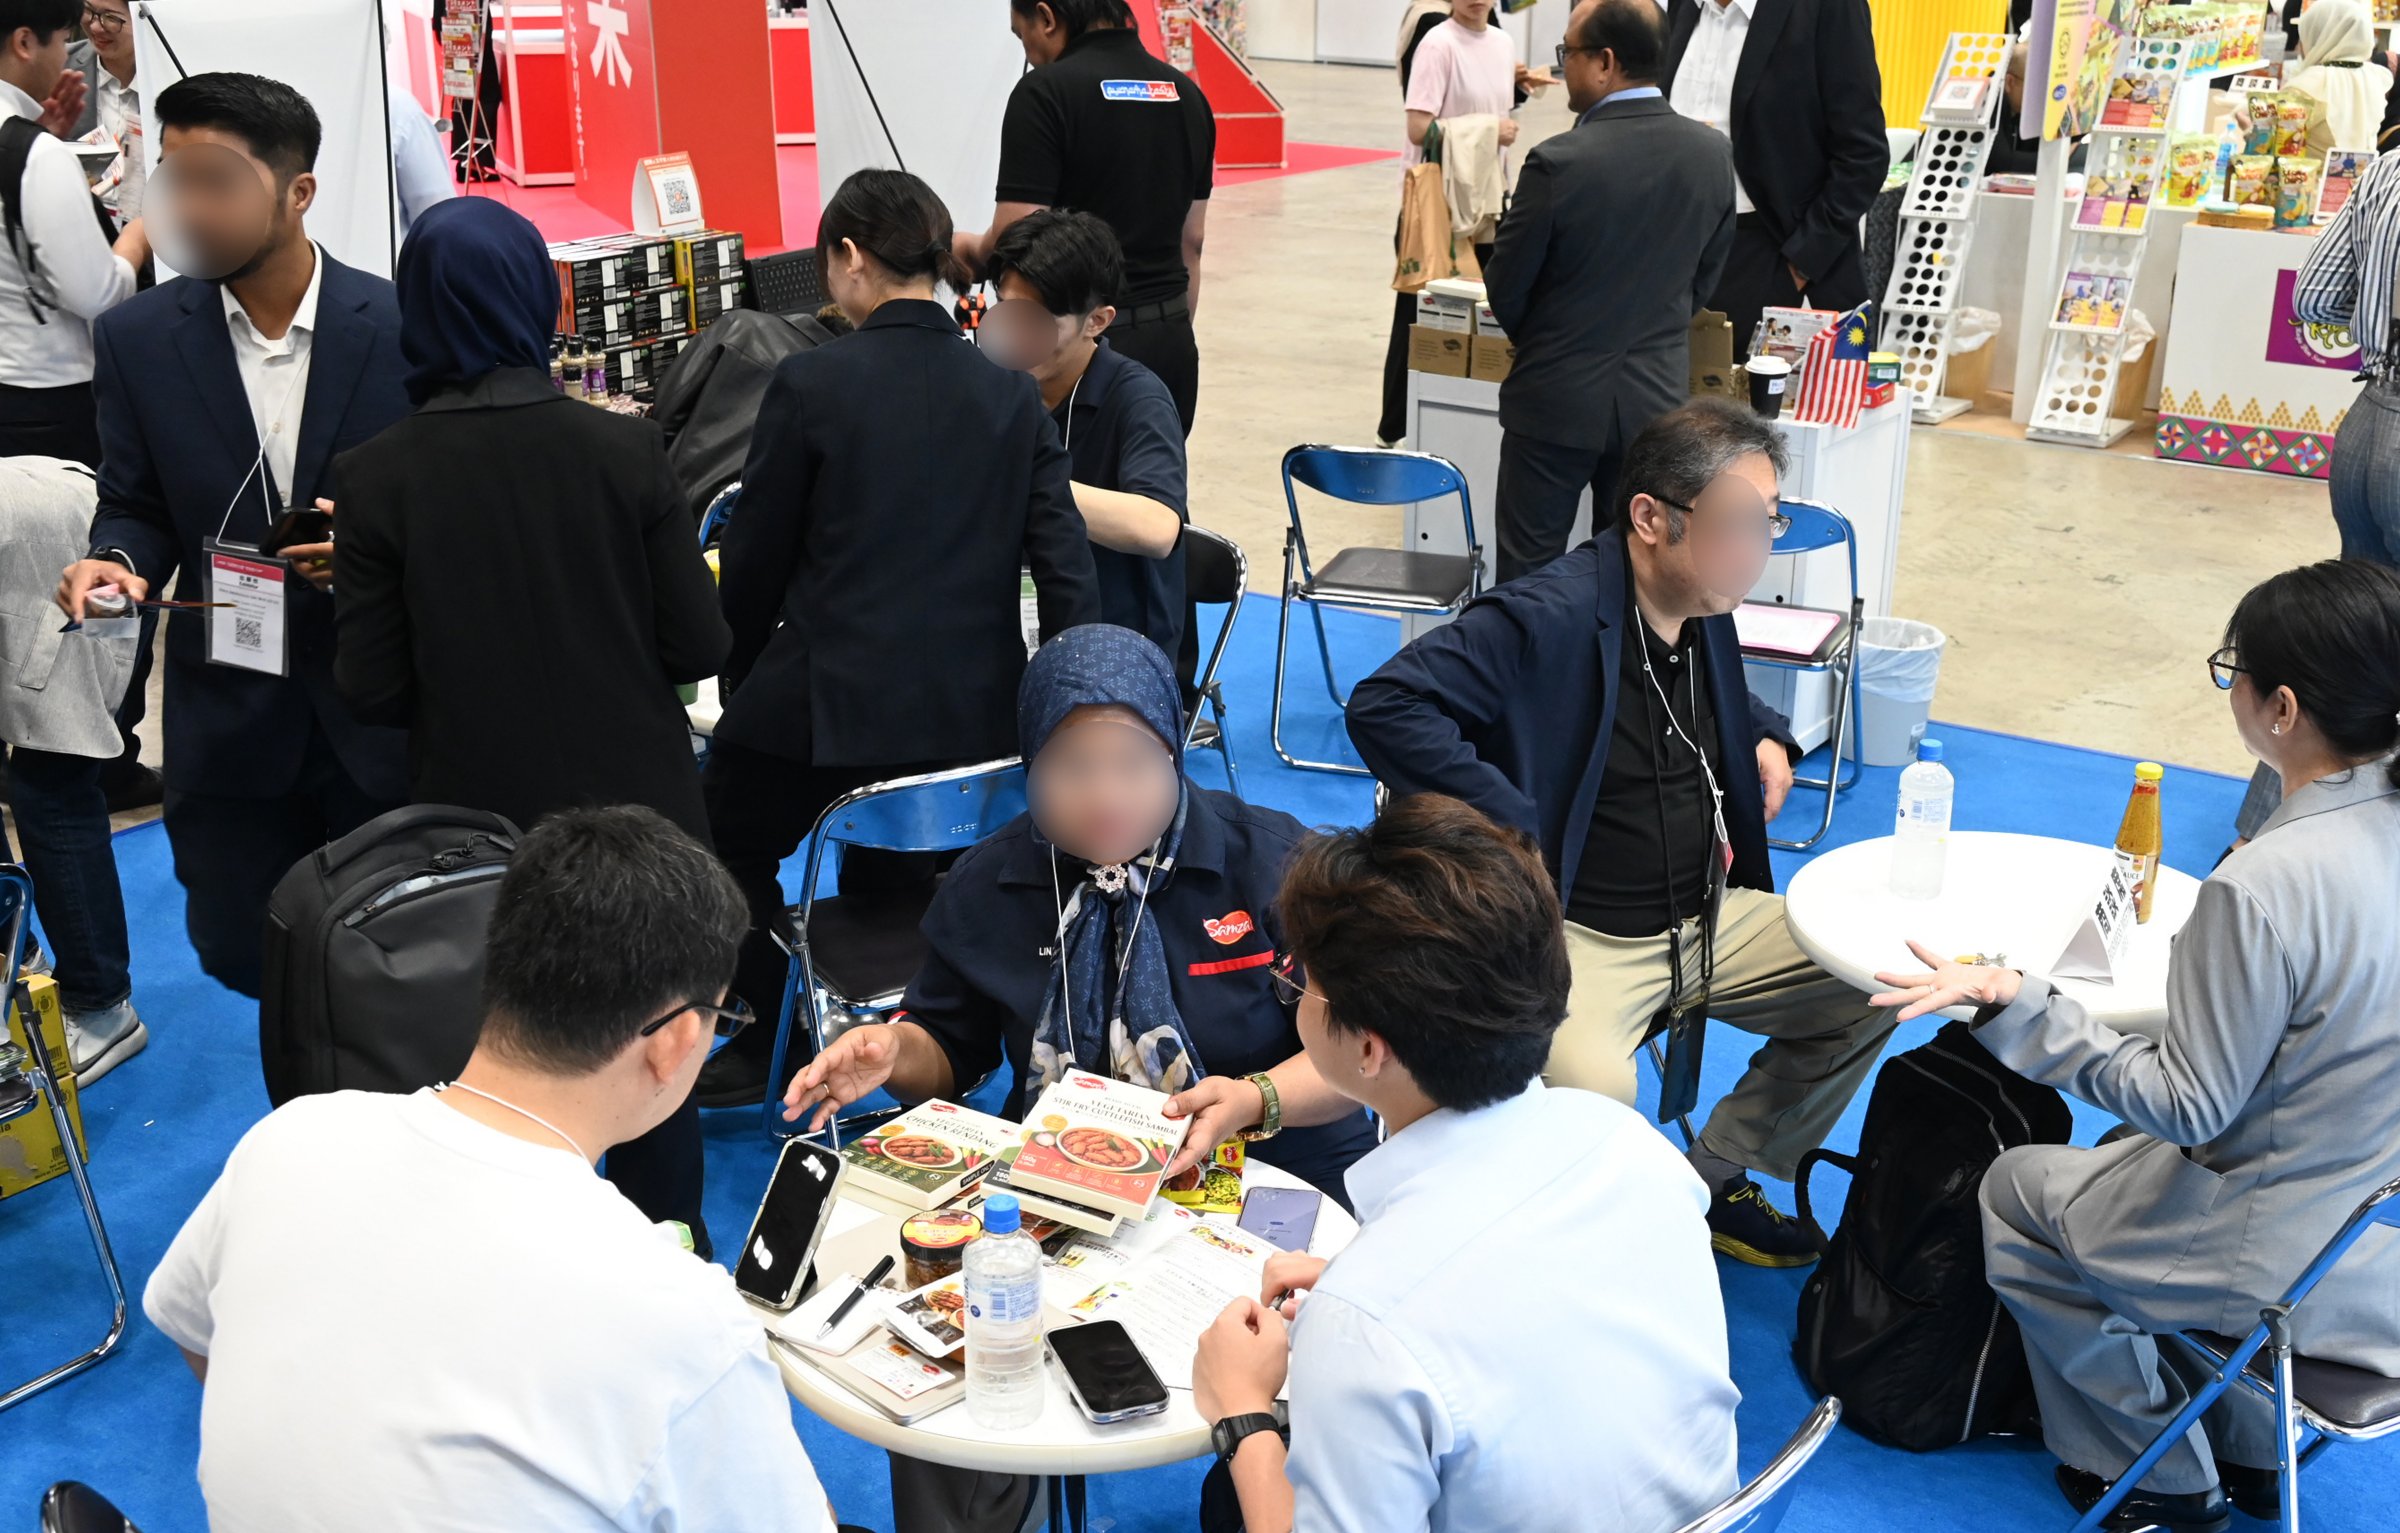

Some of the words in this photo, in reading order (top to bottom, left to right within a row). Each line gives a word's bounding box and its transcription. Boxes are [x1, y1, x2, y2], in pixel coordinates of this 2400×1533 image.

[2121, 871, 2139, 880] AUCE
[1053, 1097, 1073, 1106] STIR
[1073, 1102, 1089, 1112] FRY
[1091, 1107, 1145, 1126] CUTTLEFISH
[1146, 1122, 1179, 1136] SAMBAL
[1091, 1099, 1152, 1121] VEGETARIAN
[906, 1115, 949, 1131] CHICKEN
[950, 1128, 999, 1148] RENDANG
[962, 1171, 980, 1186] SAMPLE
[980, 1163, 993, 1174] ONLY
